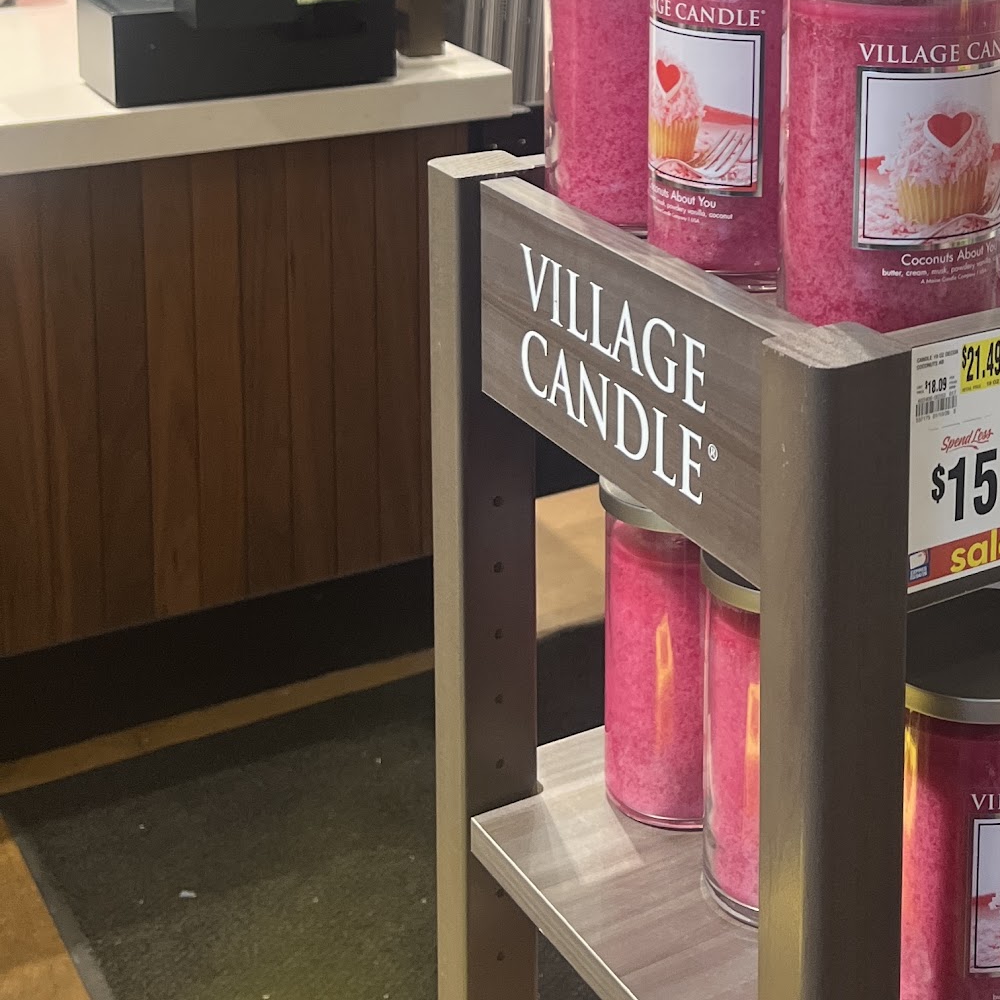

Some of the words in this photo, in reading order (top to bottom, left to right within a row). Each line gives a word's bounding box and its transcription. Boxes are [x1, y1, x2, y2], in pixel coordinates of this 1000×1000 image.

[858, 42, 960, 64] VILLAGE
[670, 190, 695, 205] About
[698, 195, 716, 209] You
[901, 253, 953, 266] Coconuts
[957, 247, 984, 262] About
[882, 268, 903, 278] butter,
[905, 268, 929, 277] cream,
[520, 242, 706, 414] VILLAGE
[925, 377, 947, 394] $18.09
[941, 430, 972, 452] Spend
[972, 427, 993, 443] Less
[932, 449, 998, 521] $15
